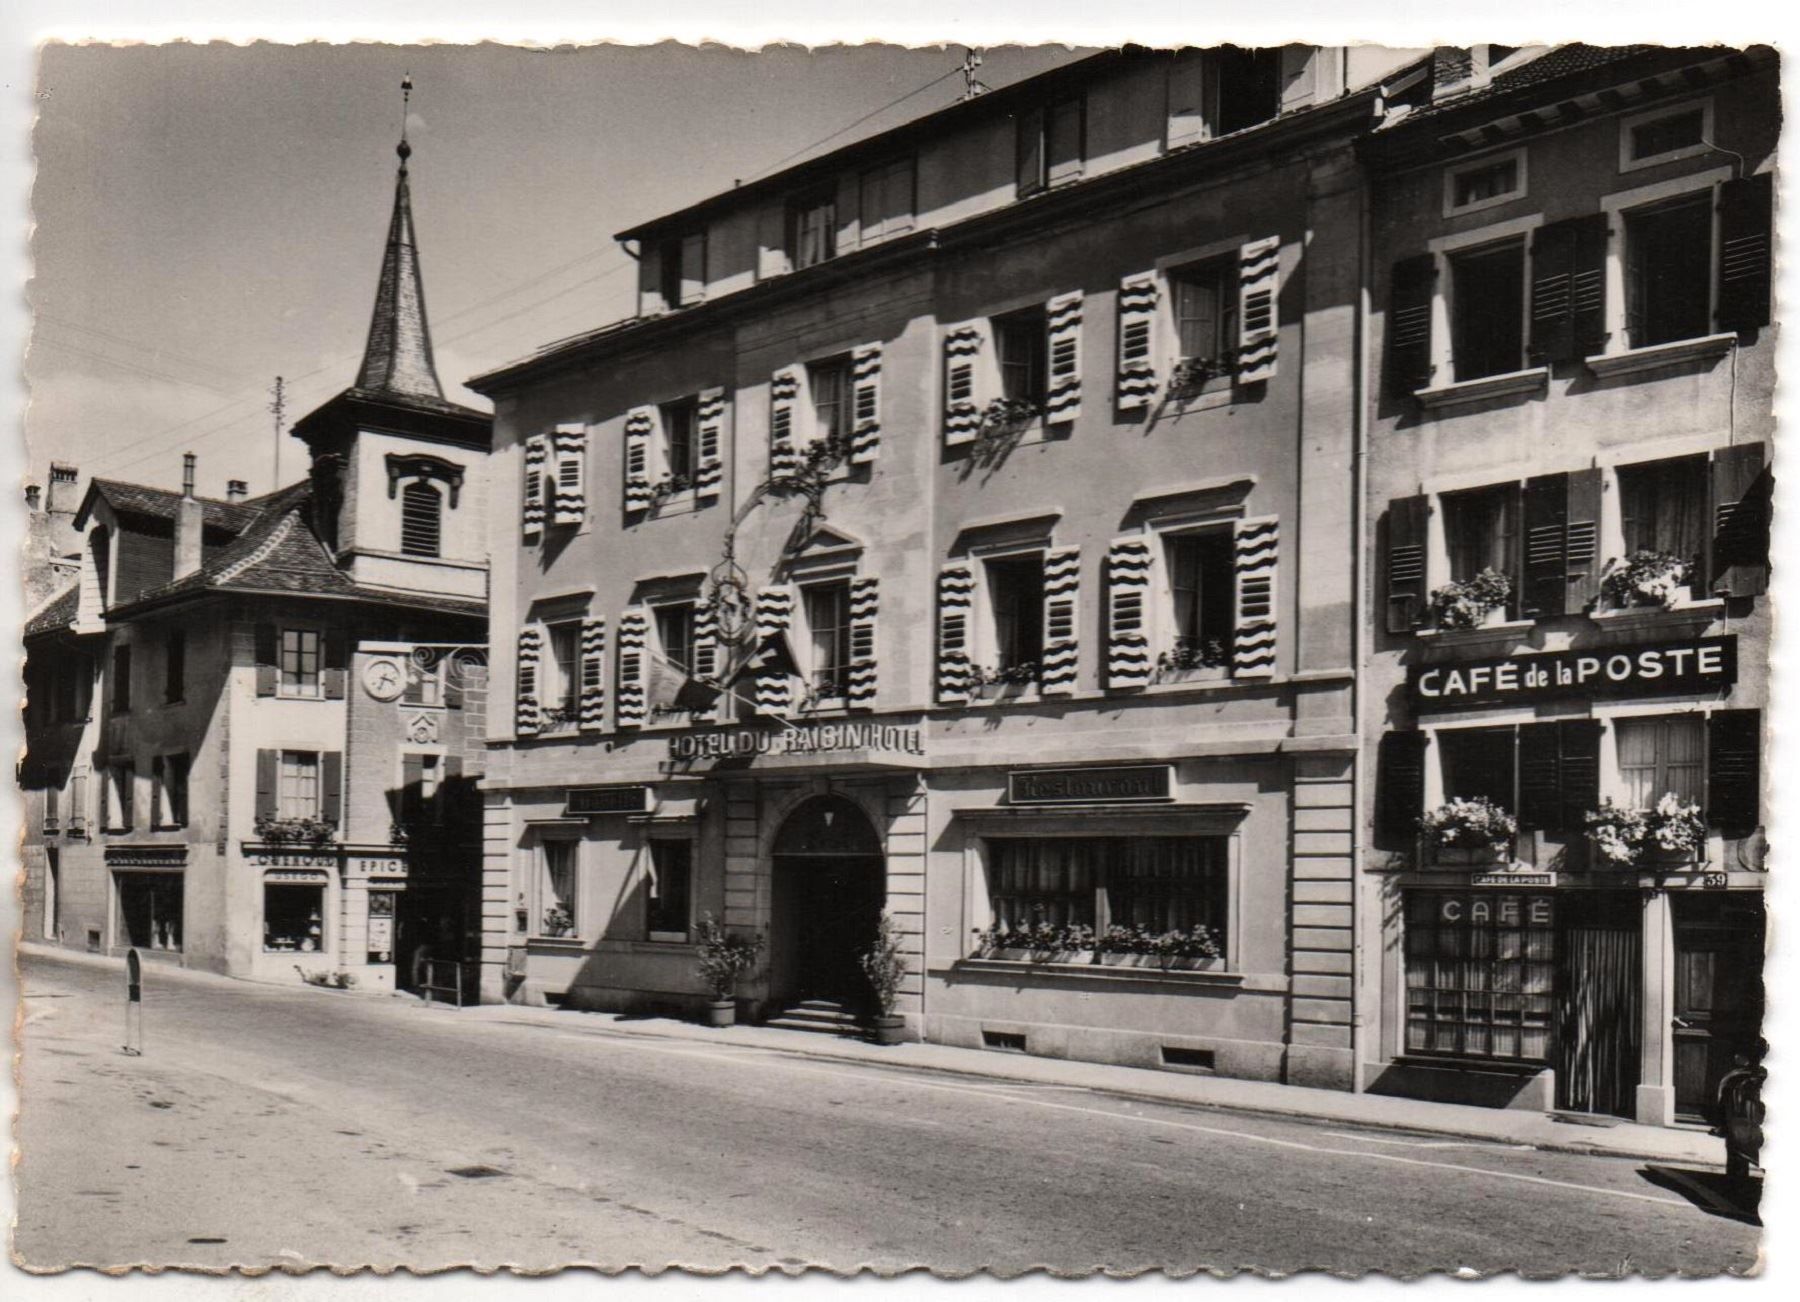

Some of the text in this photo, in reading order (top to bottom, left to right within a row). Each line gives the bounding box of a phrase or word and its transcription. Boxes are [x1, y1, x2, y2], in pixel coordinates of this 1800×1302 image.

[1419, 646, 1722, 697] CAFÉ de la POSTE
[669, 724, 864, 759] HOTEL DU RAISIN
[869, 724, 925, 756] HOTEL
[1707, 874, 1726, 886] 39
[1443, 899, 1549, 922] CAFÉ
